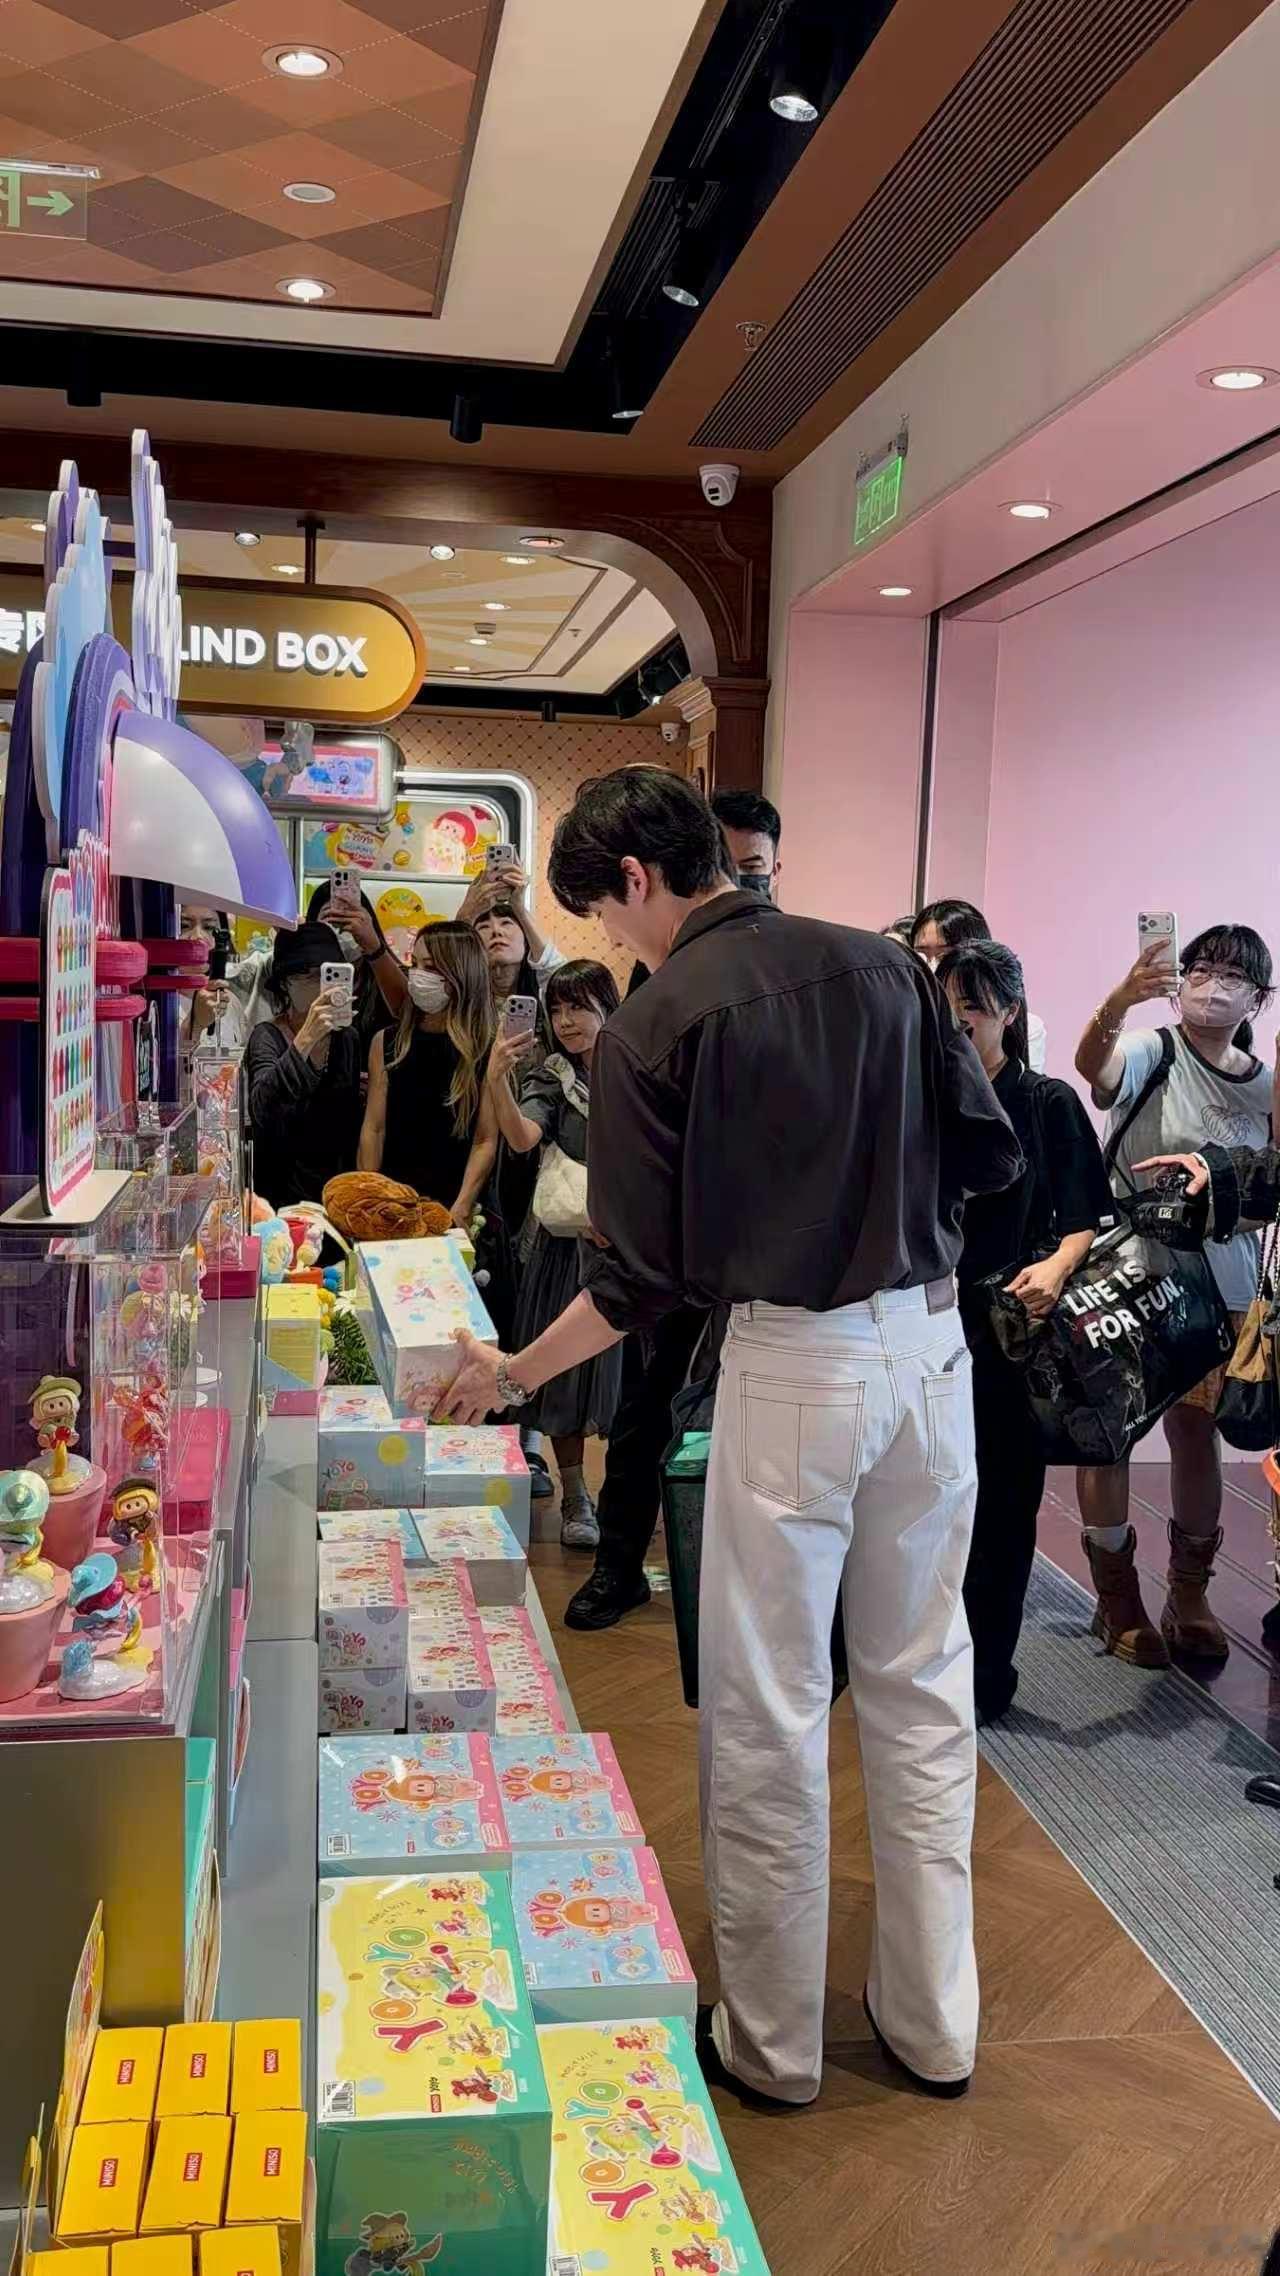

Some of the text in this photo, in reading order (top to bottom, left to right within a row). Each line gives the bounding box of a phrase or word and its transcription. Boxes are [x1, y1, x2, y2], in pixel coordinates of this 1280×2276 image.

[180, 625, 369, 674] IND BOX
[1063, 1260, 1146, 1316] LIFE IS
[1084, 1275, 1185, 1349] FOR FUN.
[118, 2060, 134, 2084] MINISO
[192, 2054, 205, 2077] MINISO
[265, 2049, 278, 2072] MINISO
[101, 2159, 117, 2187] MINISO
[185, 2153, 201, 2181] MINISO
[266, 2148, 280, 2176] MINISO
